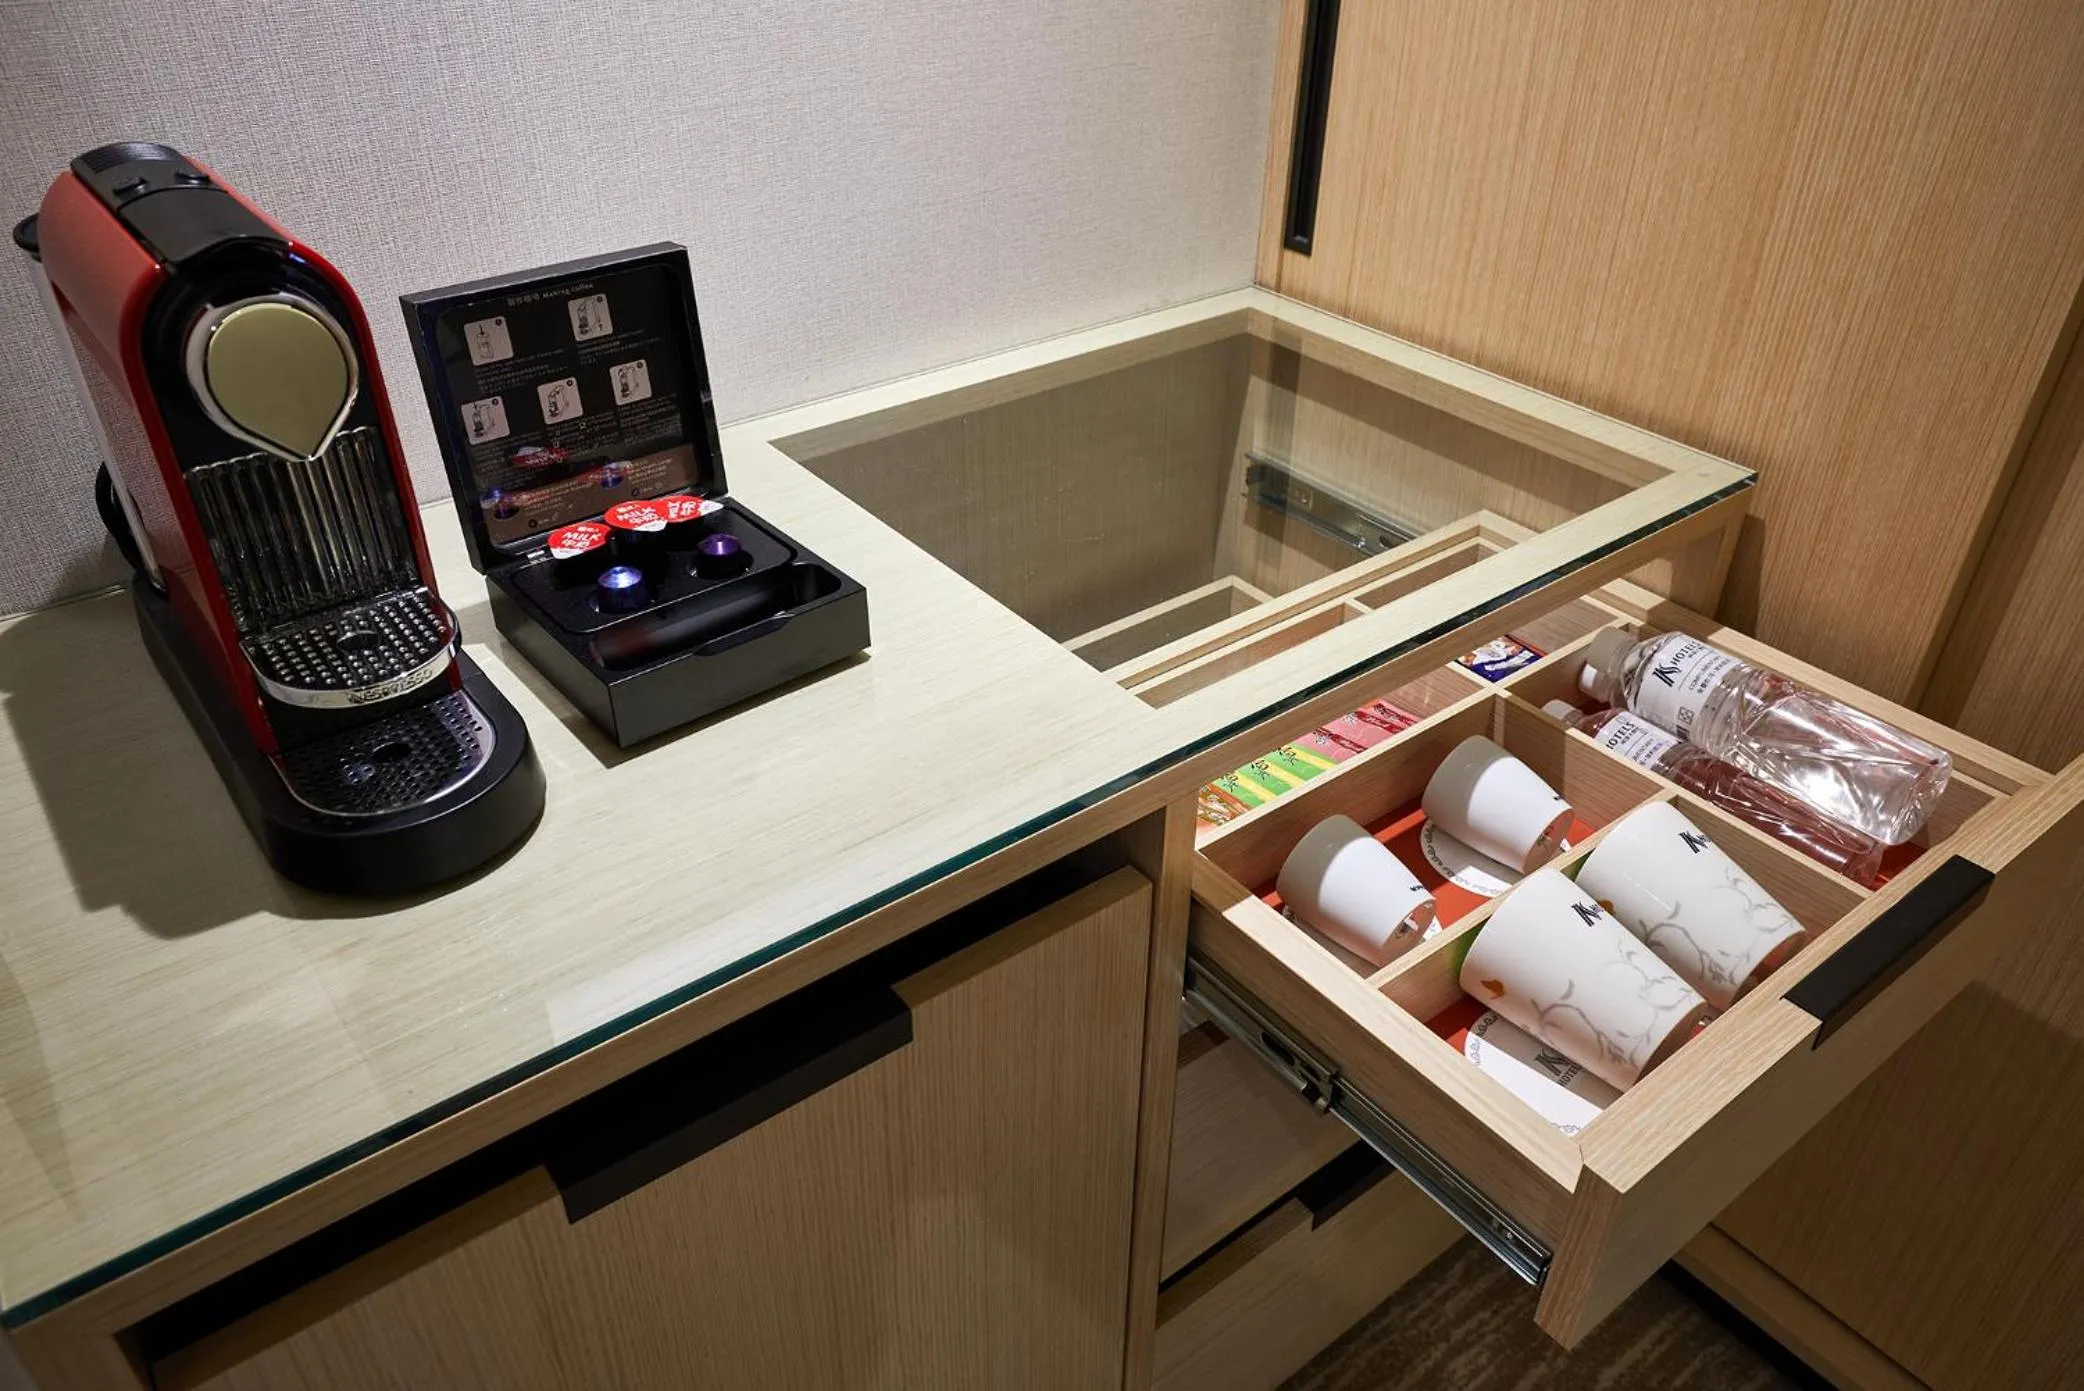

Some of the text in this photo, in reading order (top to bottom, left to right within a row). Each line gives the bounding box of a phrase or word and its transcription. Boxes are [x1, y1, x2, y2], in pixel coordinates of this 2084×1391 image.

[617, 506, 657, 521] MILK
[562, 531, 603, 541] MILK
[1556, 1062, 1583, 1088] HOTEL
